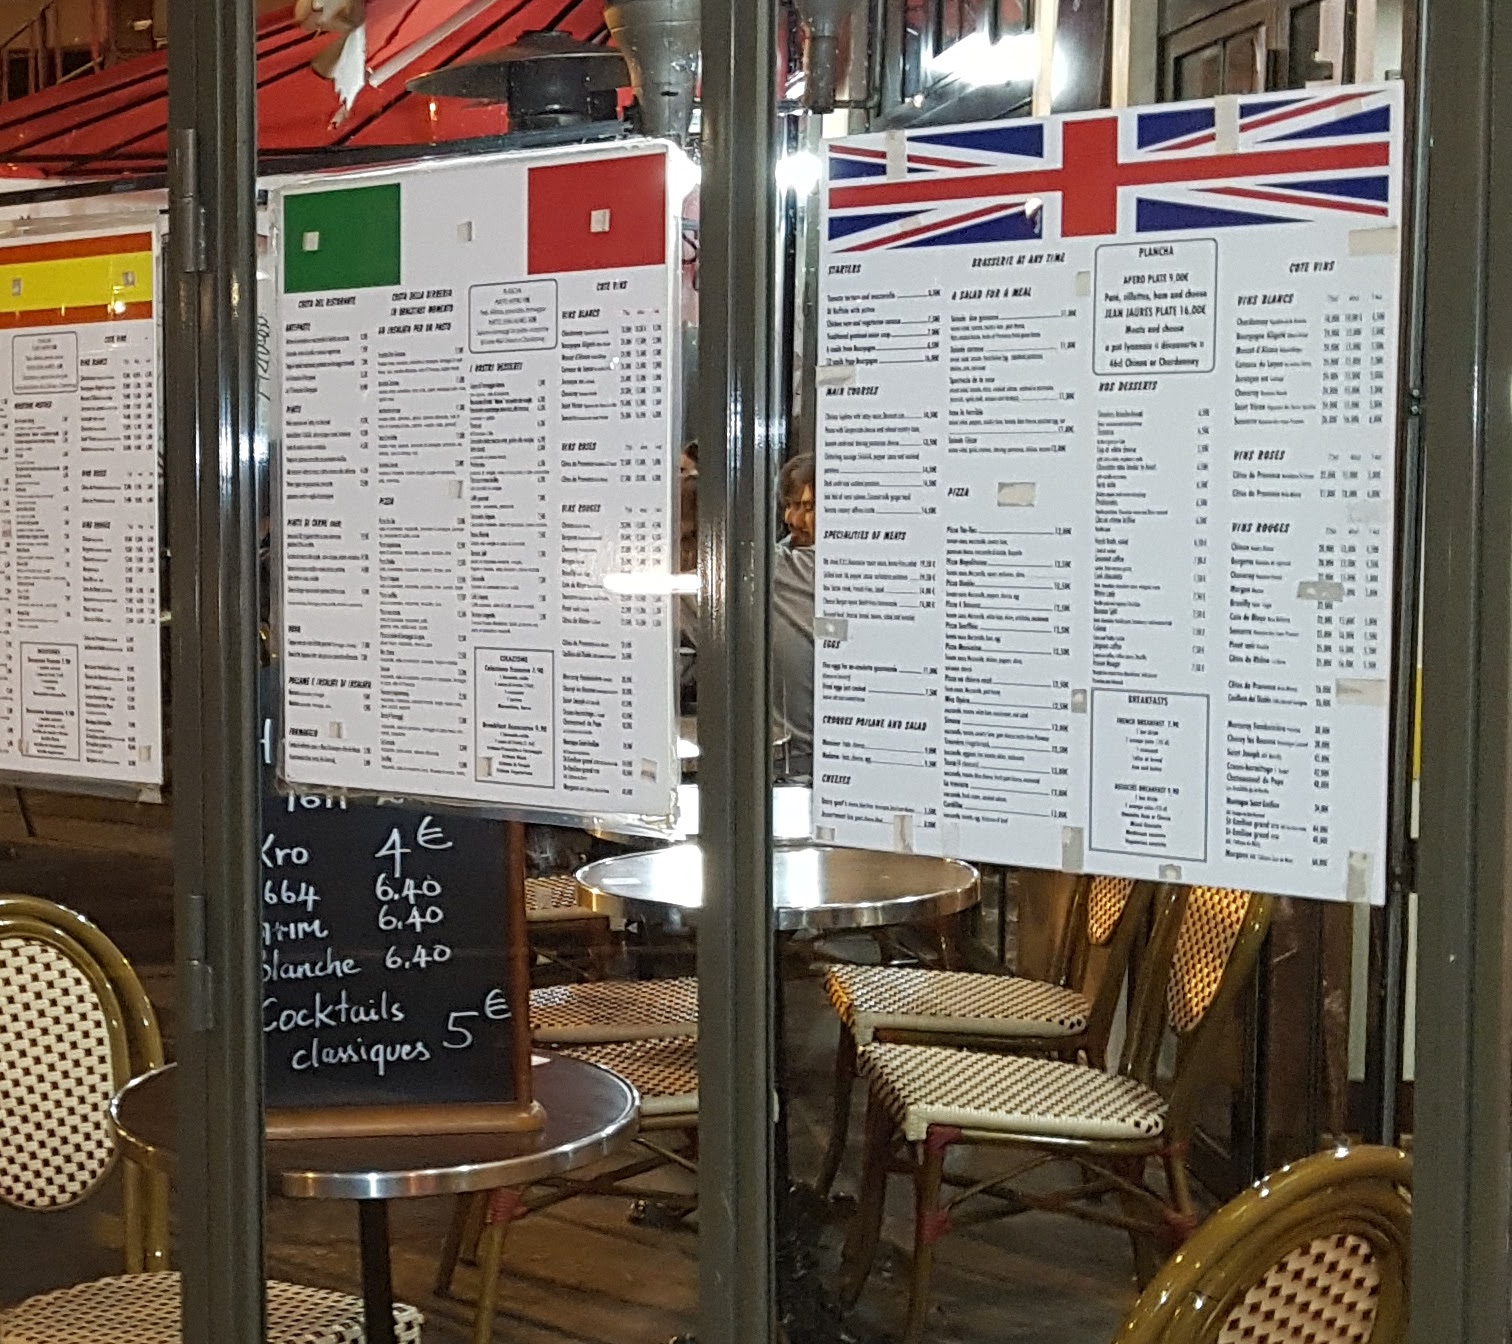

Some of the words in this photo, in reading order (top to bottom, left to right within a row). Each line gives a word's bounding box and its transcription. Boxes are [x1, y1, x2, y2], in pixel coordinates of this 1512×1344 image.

[1138, 245, 1174, 258] PLANCHA
[971, 255, 1014, 268] BRASSERIE
[1117, 380, 1158, 392] DESSERTS
[1233, 449, 1255, 461] VINS
[947, 486, 970, 497] PIZZA
[1231, 522, 1253, 533] VINS
[822, 639, 841, 649] EGGS
[374, 872, 442, 905] 6.40
[377, 904, 445, 933] 6.40
[384, 944, 453, 970] 6.40
[290, 1036, 431, 1077] classiques
